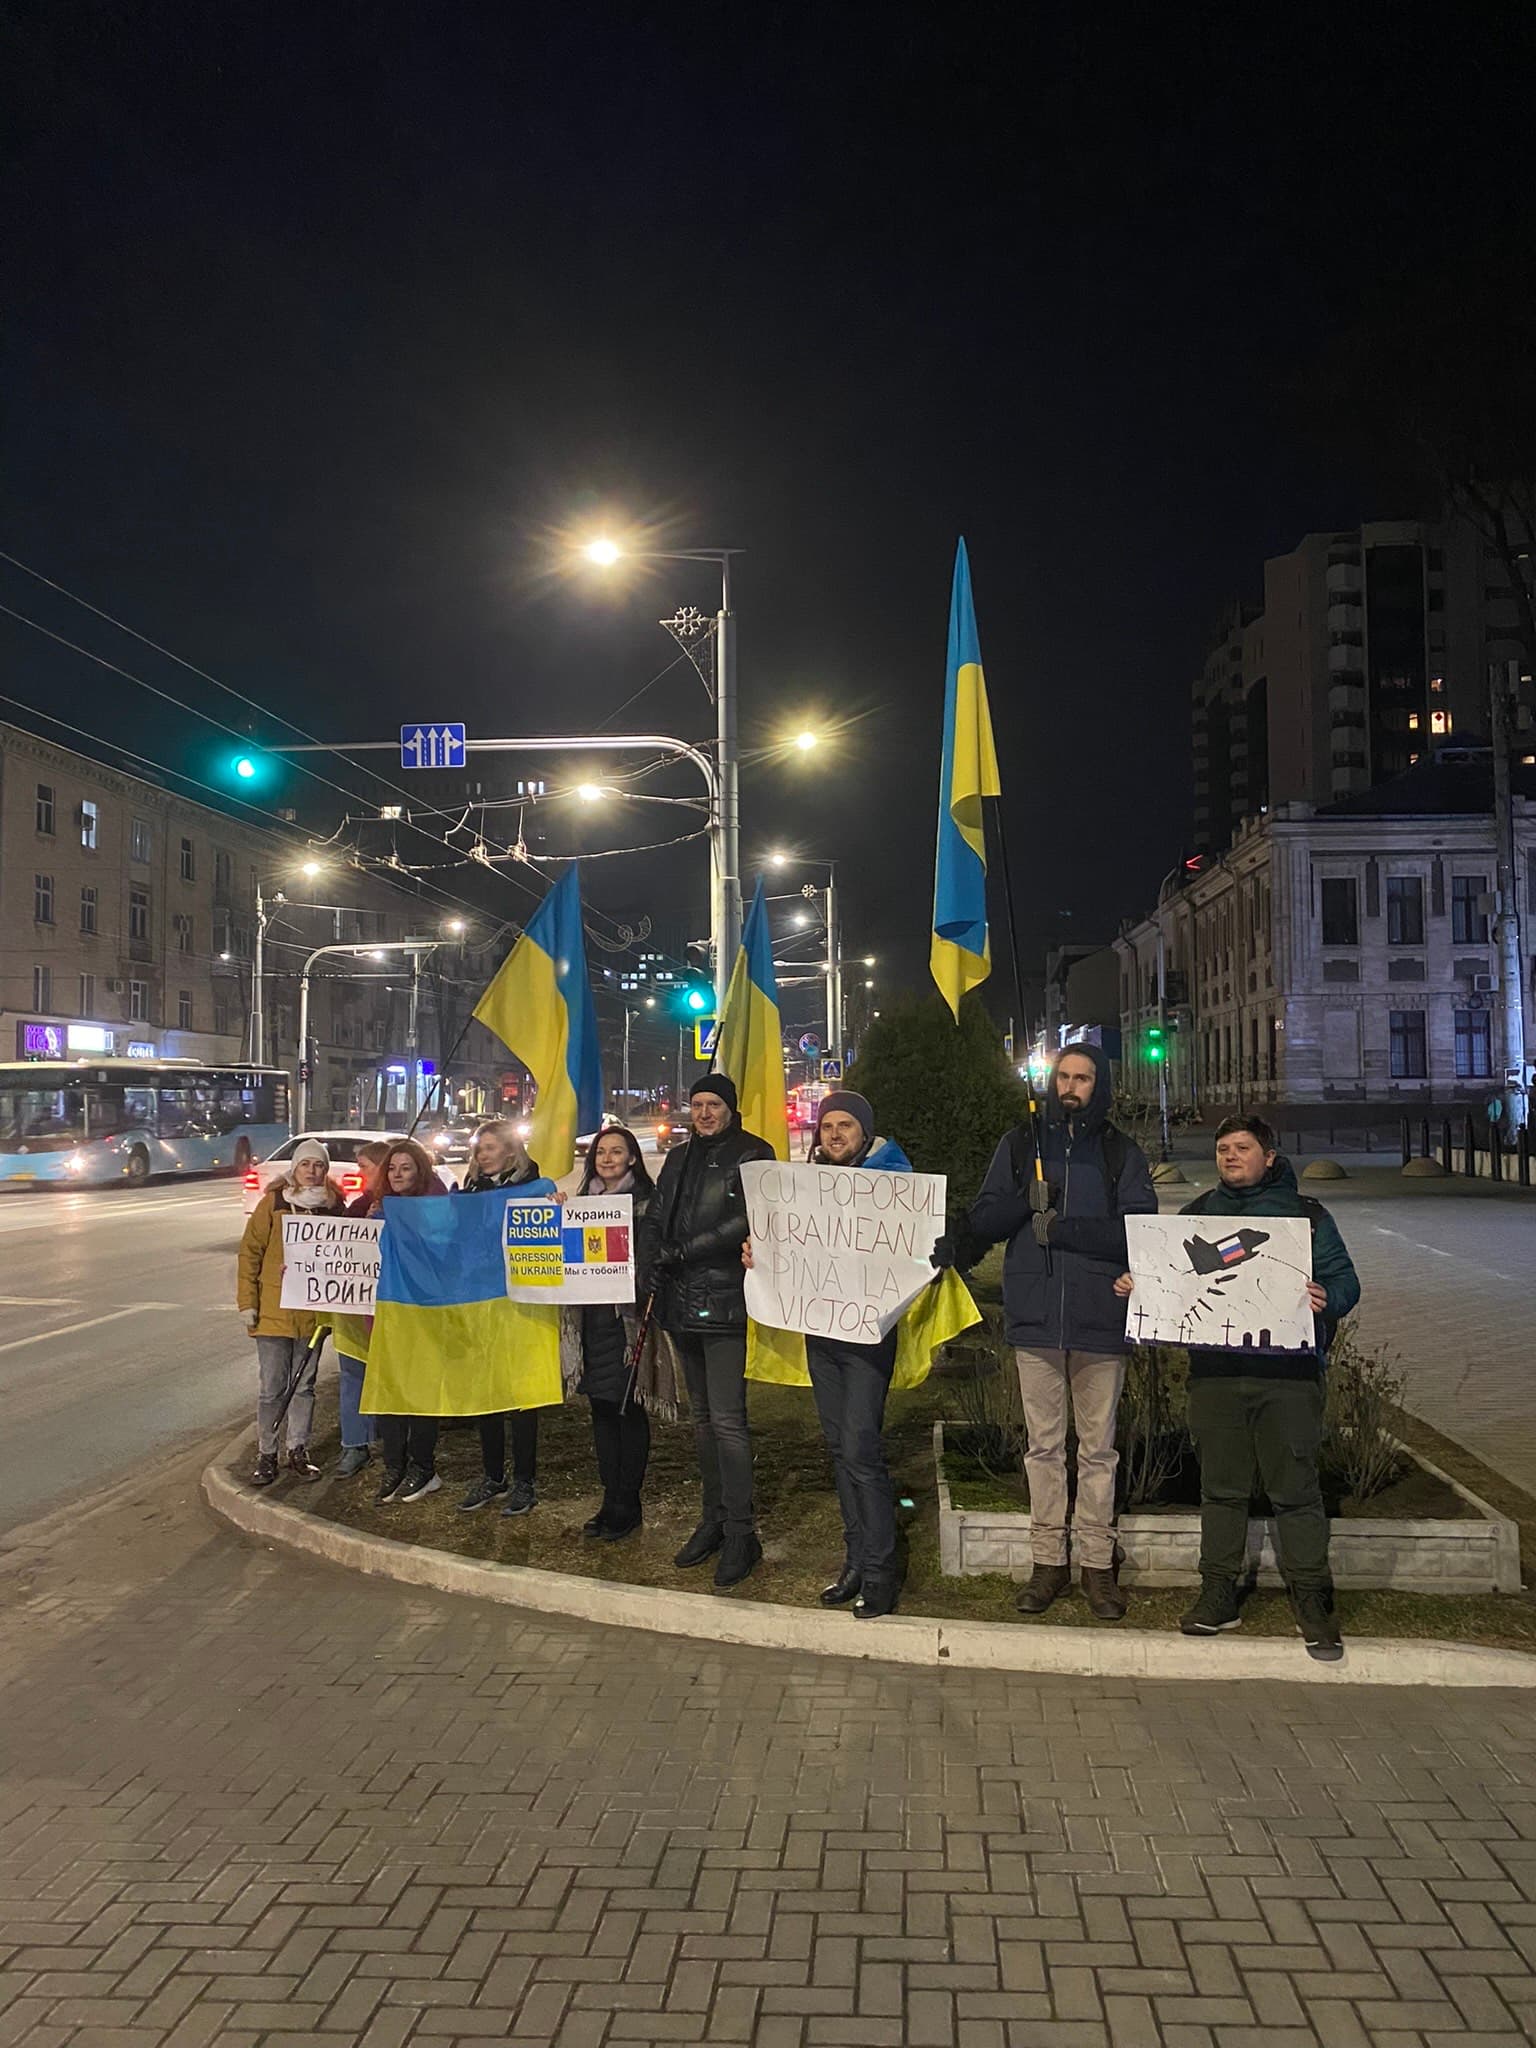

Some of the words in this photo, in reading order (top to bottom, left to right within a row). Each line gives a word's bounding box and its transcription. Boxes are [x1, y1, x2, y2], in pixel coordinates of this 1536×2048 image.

[759, 1168, 796, 1204] CU
[818, 1170, 945, 1217] POPORUL
[512, 1208, 554, 1225] STOP
[566, 1209, 621, 1222] Украина
[286, 1222, 378, 1243] ПОСИГНАЛ
[509, 1226, 559, 1239] RUSSIAN
[752, 1209, 916, 1257] UCRAINEAN
[315, 1244, 353, 1258] ЕСЛИ
[510, 1252, 562, 1263] AGRESSION
[294, 1261, 315, 1273] ТЫ
[325, 1260, 380, 1279] ПРОТИВ
[521, 1266, 562, 1276] UKRAINE
[564, 1266, 580, 1276] Мы
[590, 1265, 628, 1275] тобой!!!
[772, 1250, 844, 1294] PÎNĂ
[864, 1263, 900, 1300] LA
[307, 1276, 373, 1304] ВОЙН
[778, 1291, 888, 1337] VICTOR
